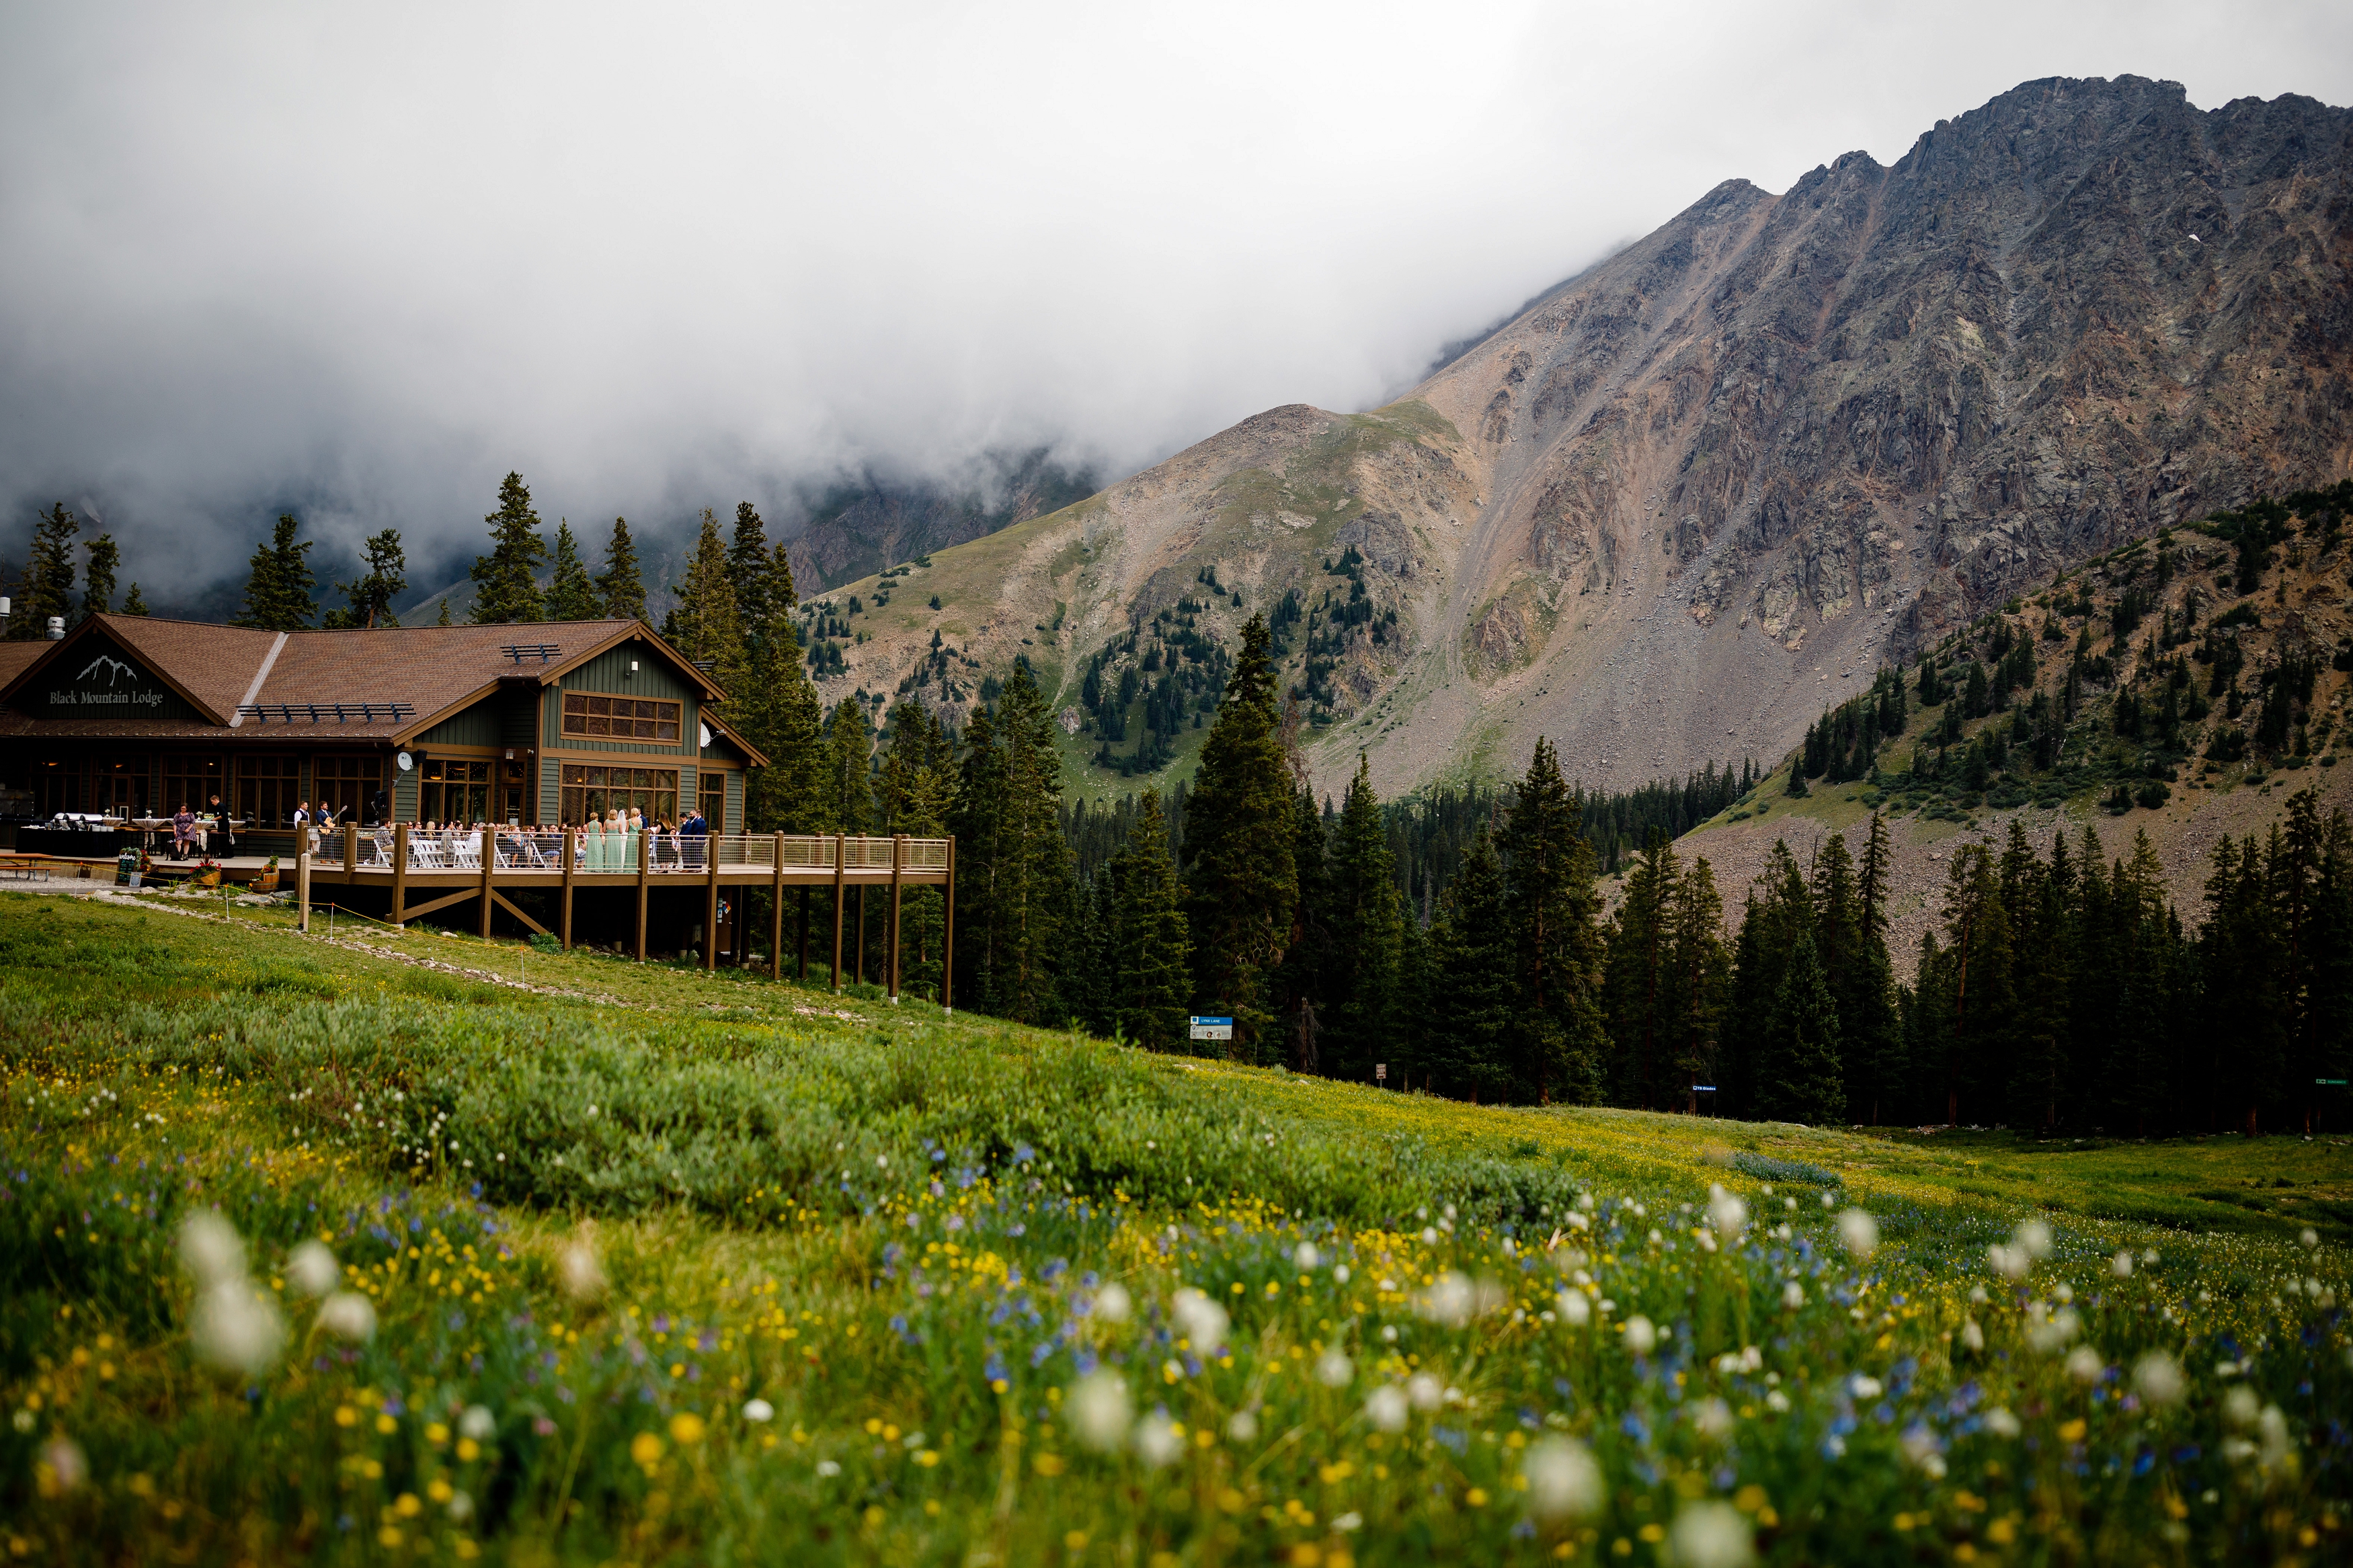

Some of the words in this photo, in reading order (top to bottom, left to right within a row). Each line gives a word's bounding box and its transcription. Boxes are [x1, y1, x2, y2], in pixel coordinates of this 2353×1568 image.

[50, 690, 77, 704] Black
[81, 690, 128, 704] Mountain
[132, 689, 163, 707] Lodge
[119, 852, 136, 860] welcome
